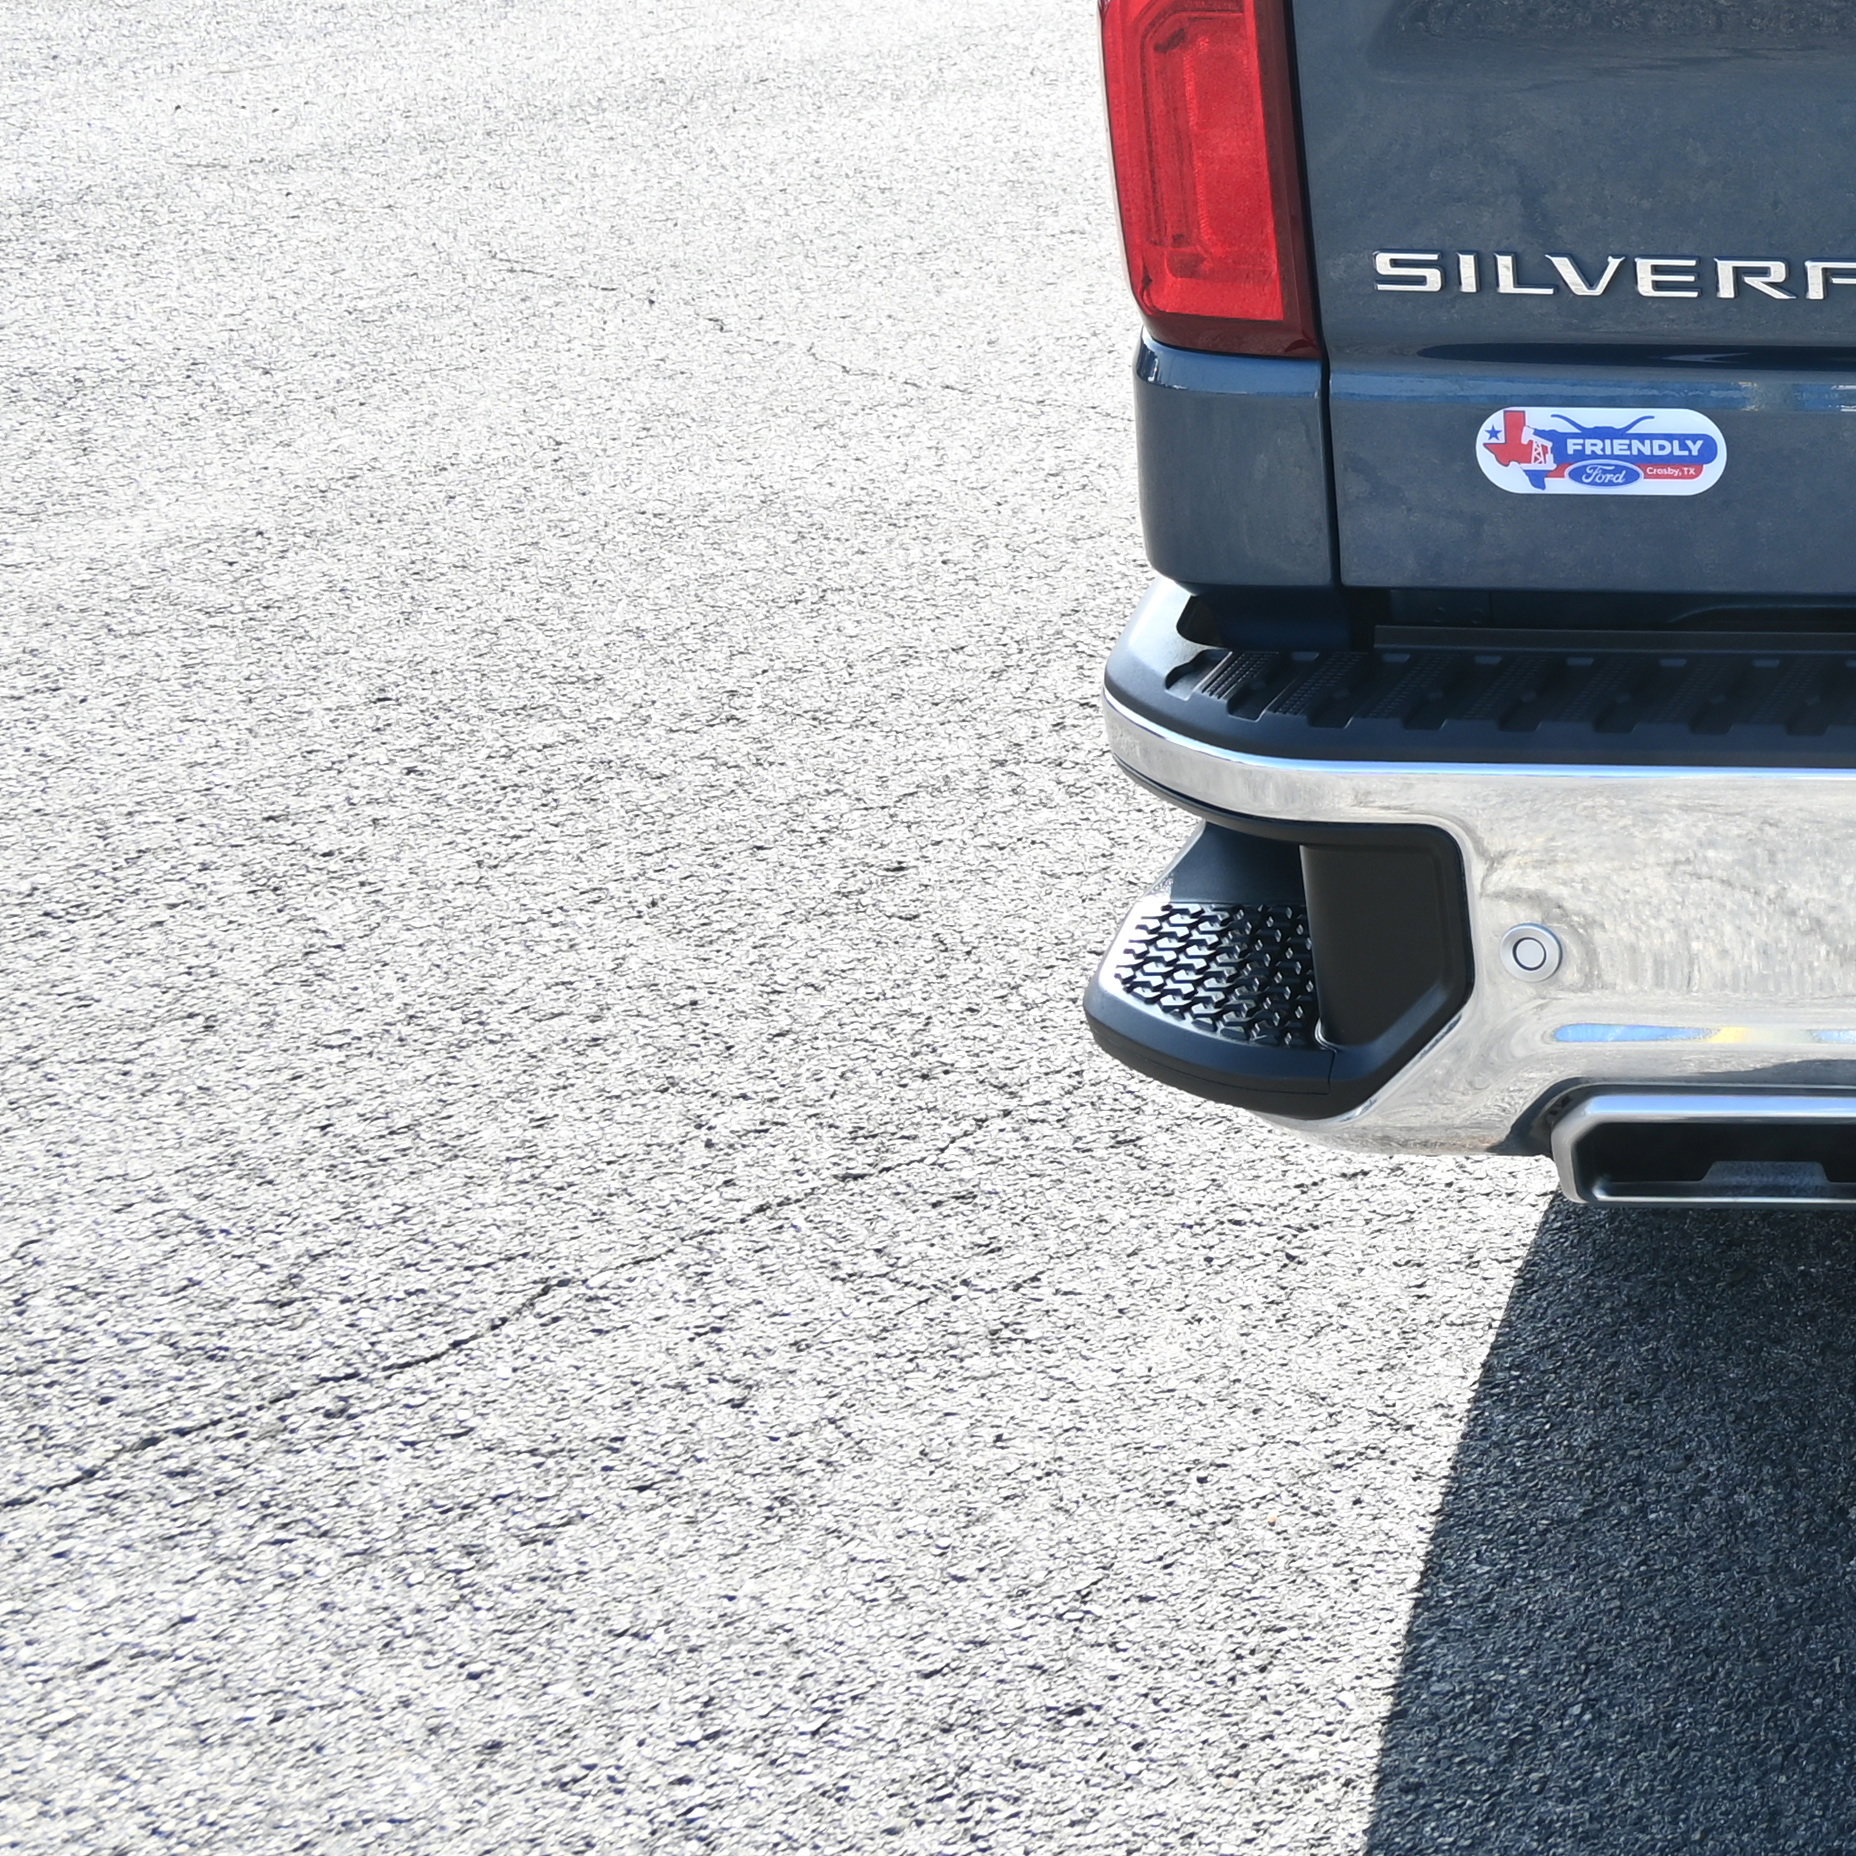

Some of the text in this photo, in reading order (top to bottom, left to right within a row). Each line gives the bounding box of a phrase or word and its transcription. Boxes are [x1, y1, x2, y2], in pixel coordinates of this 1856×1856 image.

[1566, 439, 1704, 456] FRIENDLY
[1581, 466, 1626, 485] Ford
[1646, 467, 1696, 477] Crosby, TX
